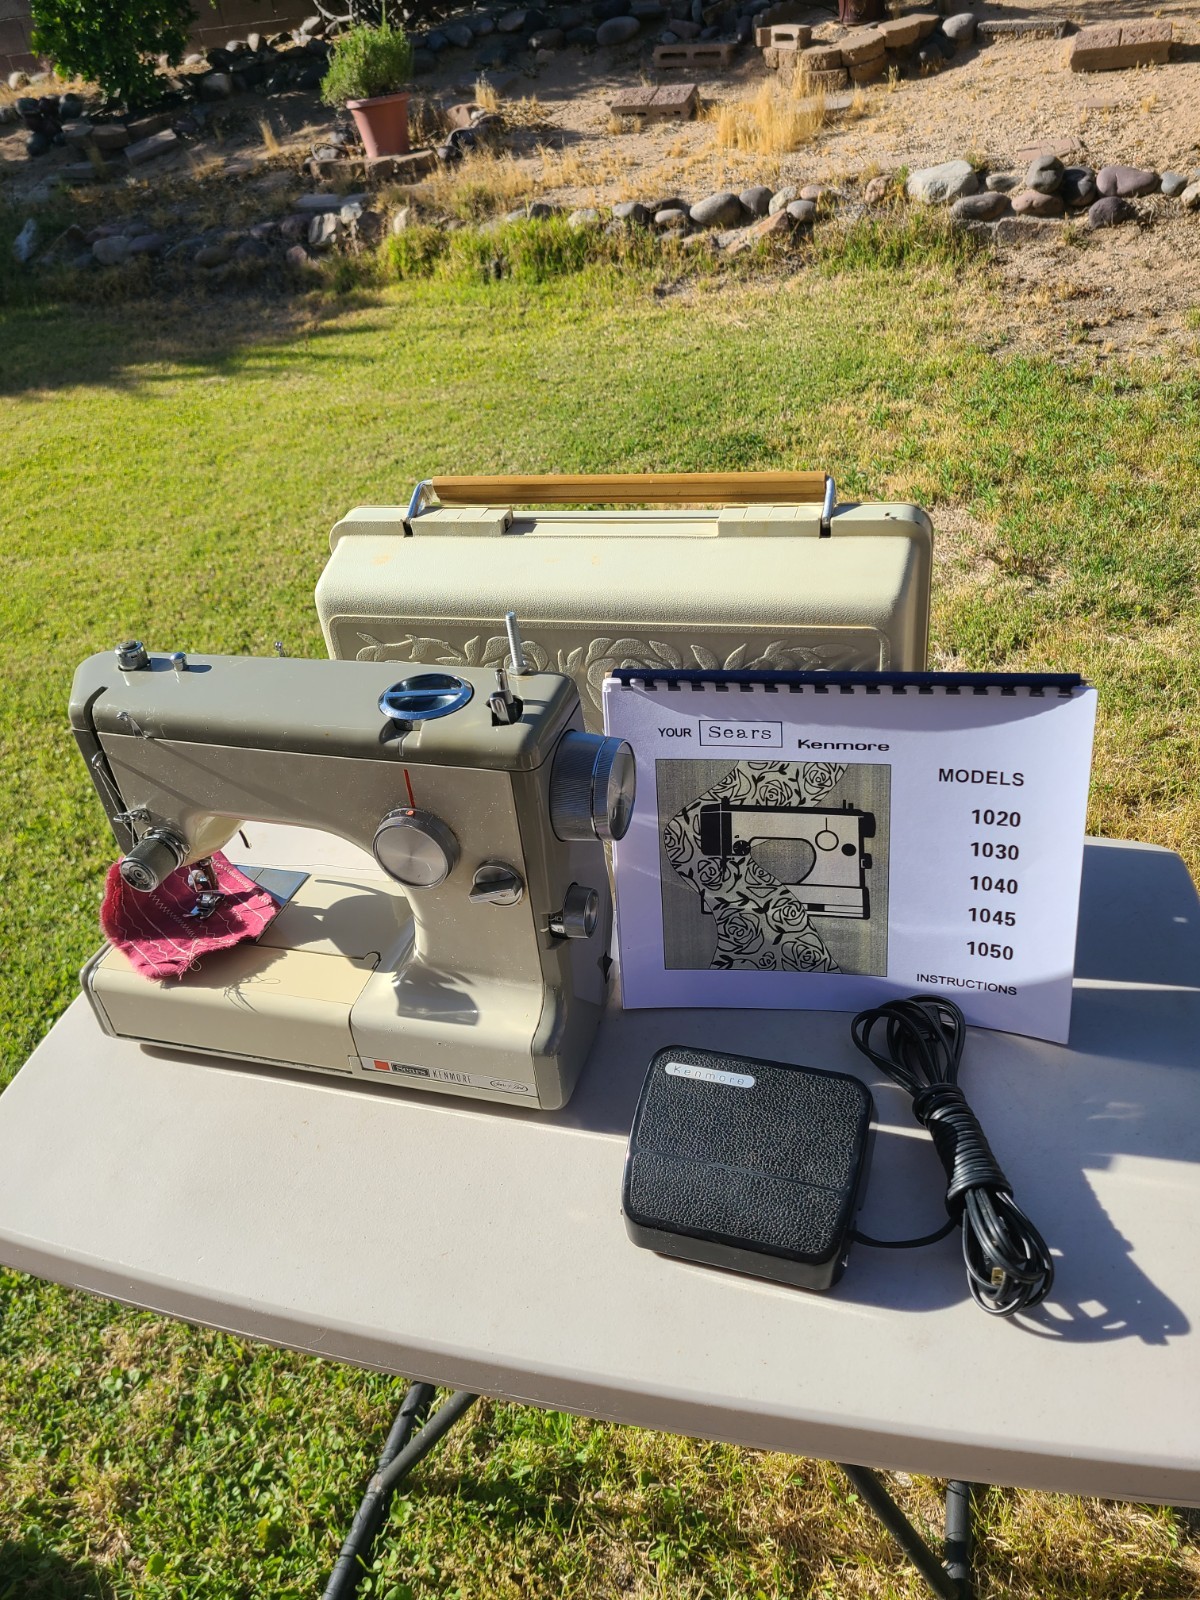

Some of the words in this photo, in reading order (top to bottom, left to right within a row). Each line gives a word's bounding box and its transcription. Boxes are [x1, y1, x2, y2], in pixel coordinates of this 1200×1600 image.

[657, 727, 692, 738] YOUR
[708, 725, 772, 740] Sears
[797, 739, 890, 752] Kenmore
[938, 768, 1025, 787] MODELS
[971, 809, 1021, 827] 1020
[970, 842, 1019, 861] 1030
[969, 875, 1018, 894] 1040
[968, 907, 1016, 927] 1045
[966, 941, 1014, 961] 1050
[916, 973, 1018, 996] INSTRUCTIONS
[432, 1069, 472, 1084] KENMORE
[673, 1065, 745, 1085] Kenmore
